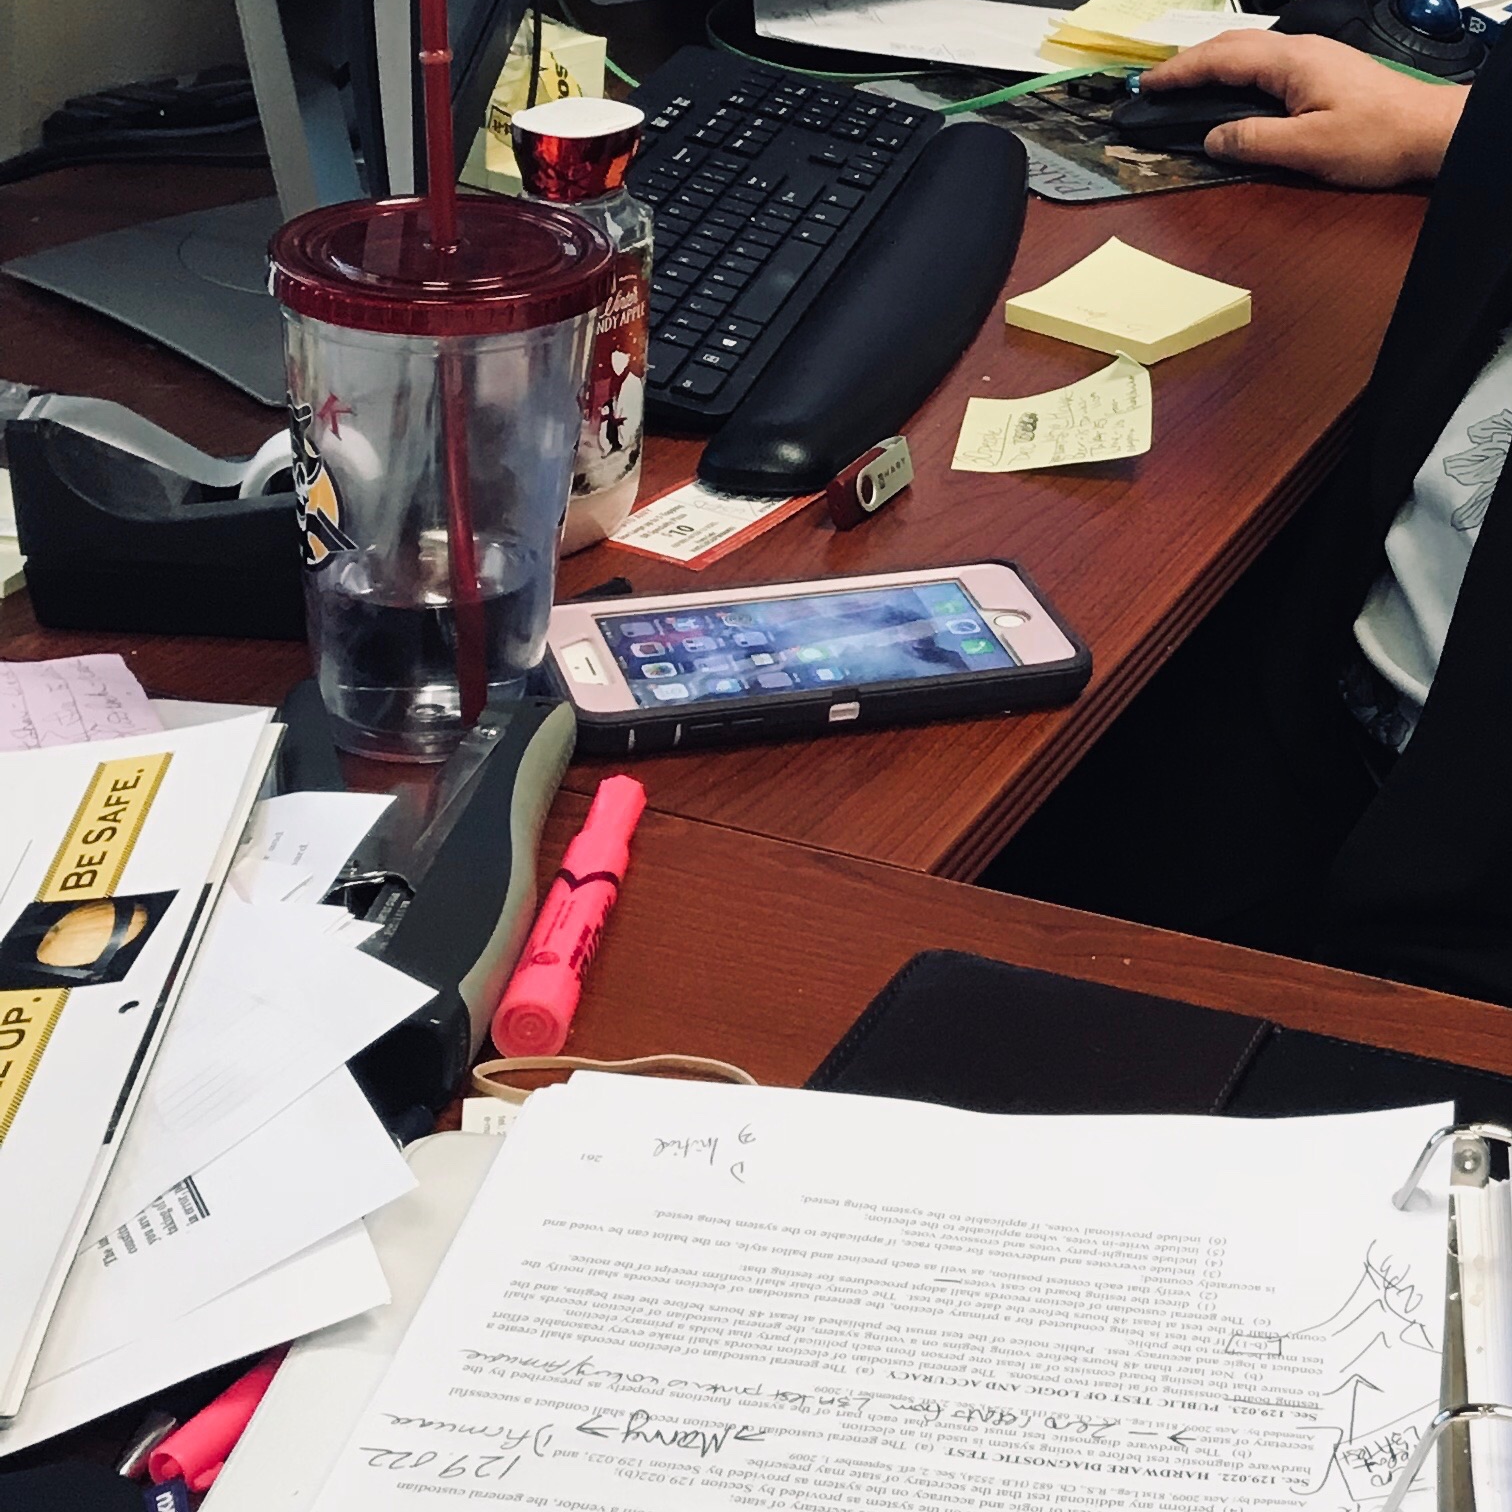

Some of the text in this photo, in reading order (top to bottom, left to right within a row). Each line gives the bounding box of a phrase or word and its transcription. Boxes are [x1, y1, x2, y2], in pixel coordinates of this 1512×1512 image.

[59, 768, 144, 892] BE SAFE.
[0, 996, 42, 1051] UP.
[571, 1152, 604, 1164] 261
[650, 1208, 1222, 1281] (3) include overvotes and undervotes for each race, if applicable to the system being tested;
[797, 1194, 1227, 1248] (6) include provisional votes, if applicable to the system being tested;
[861, 1212, 1226, 1259] (5) include write-in votes, when applicable to the election;
[898, 1226, 1224, 1270] (4) include straight-party votes and crossover votes;
[956, 1276, 1216, 1314] (1) direct the testing board to cast votes;
[482, 1321, 1318, 1424] Sec. 129.023. PUBLIC TEST OF LOGIC AND ACCURACY. (a) The general custodian of election records shall create a
[359, 1444, 522, 1481] 129.022
[444, 1386, 1310, 1490] Sec. 129.022. HARDWARE DIAGNOSTIC TEST. (a) The general custodian of election records shall conduct a successful
